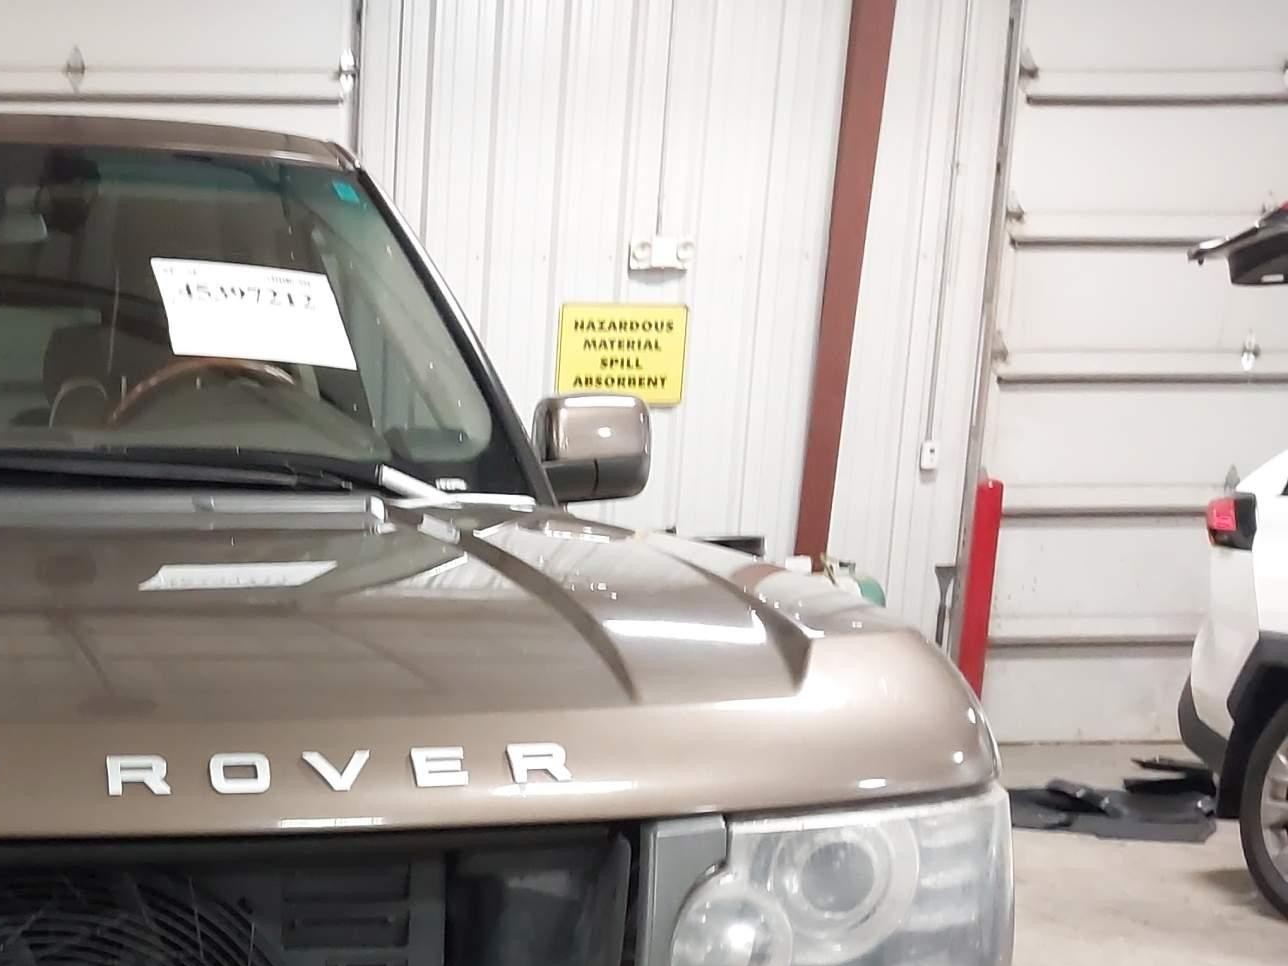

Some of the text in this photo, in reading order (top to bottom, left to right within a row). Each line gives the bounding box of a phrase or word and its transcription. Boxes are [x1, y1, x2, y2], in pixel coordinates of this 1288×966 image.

[573, 319, 674, 332] HAZARDOUS
[583, 338, 661, 351] MATERIAL
[599, 357, 643, 370] SPILL
[573, 375, 668, 389] ABSORBENT
[106, 741, 573, 797] ROVER
